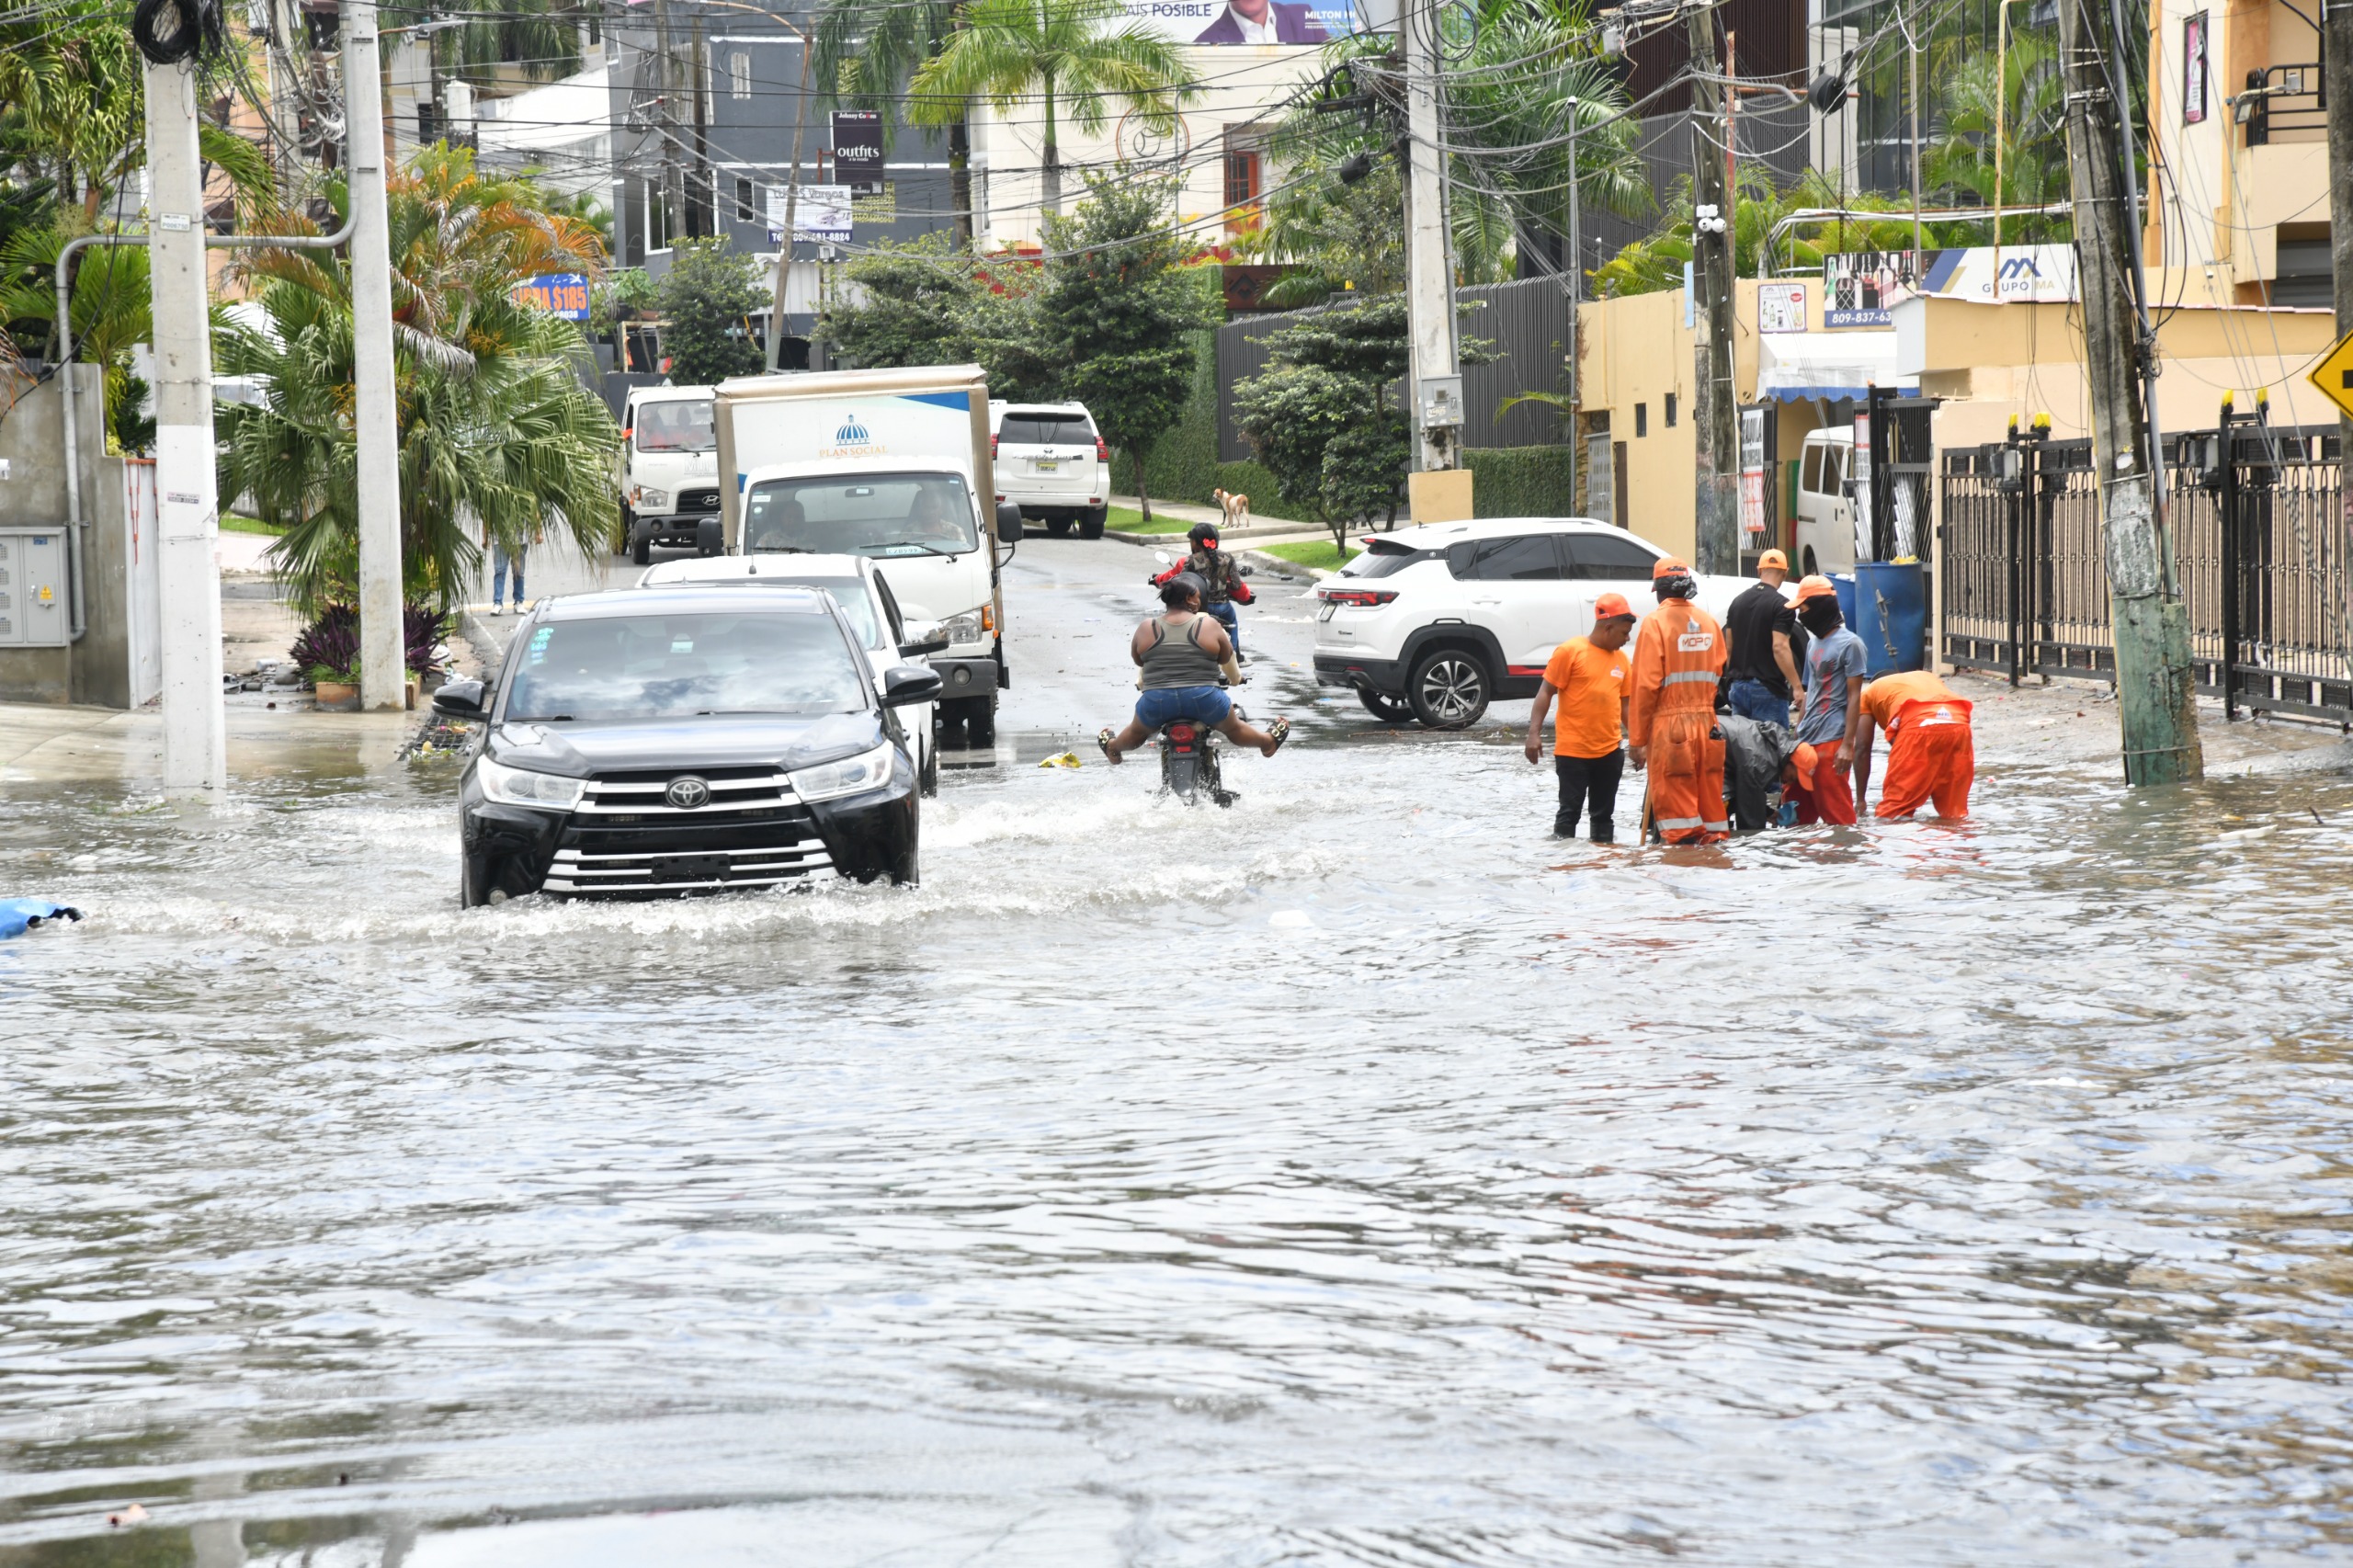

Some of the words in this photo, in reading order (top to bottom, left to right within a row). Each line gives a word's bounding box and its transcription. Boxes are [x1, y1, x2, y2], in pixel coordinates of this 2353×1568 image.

[1153, 4, 1211, 17] POSIBLE
[1304, 10, 1341, 19] MILTON
[837, 145, 880, 158] outfits
[1982, 281, 2029, 292] GUPO
[2036, 280, 2055, 290] MA
[552, 284, 587, 311] $185
[1832, 312, 1893, 324] 809-837-63
[819, 449, 847, 458] PLAN
[850, 445, 887, 456] SOCIAL
